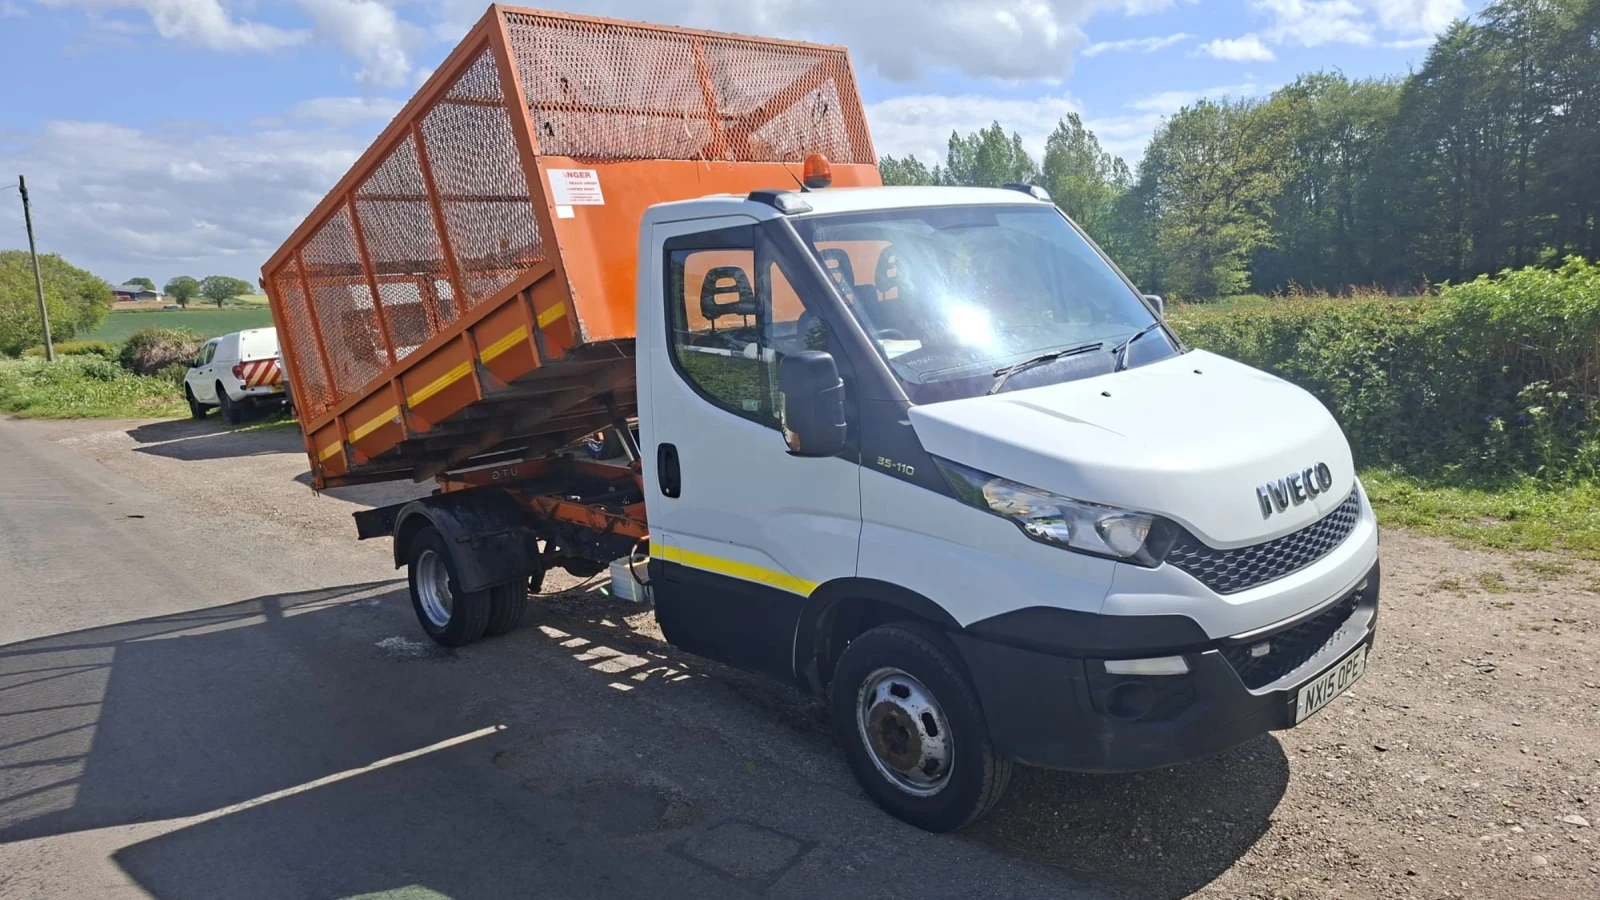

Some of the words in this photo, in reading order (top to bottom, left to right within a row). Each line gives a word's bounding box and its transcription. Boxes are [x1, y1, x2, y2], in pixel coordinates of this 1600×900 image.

[877, 456, 915, 476] 35-110
[1256, 462, 1332, 520] IVECO
[1305, 672, 1336, 714] NX15
[1338, 653, 1360, 690] OPE
